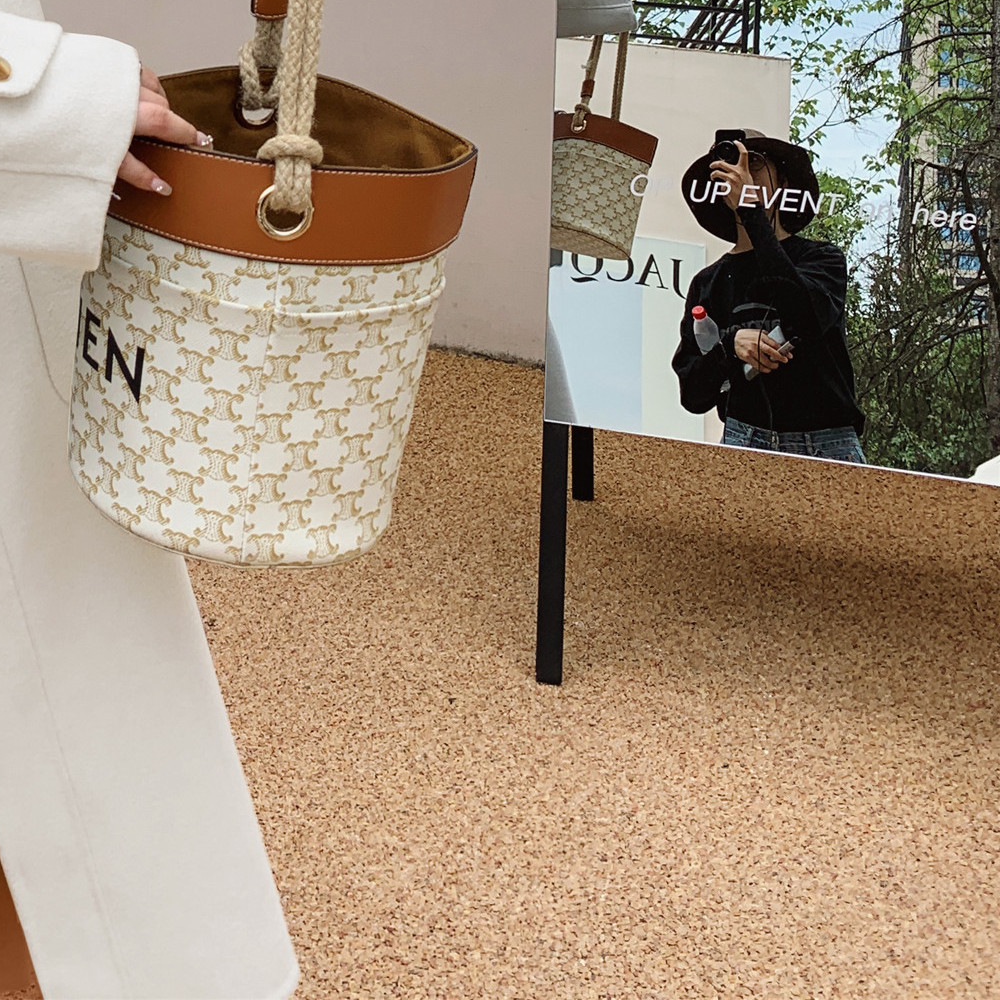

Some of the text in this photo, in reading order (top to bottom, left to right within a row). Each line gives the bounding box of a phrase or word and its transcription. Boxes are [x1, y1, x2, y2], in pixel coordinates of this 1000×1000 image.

[689, 179, 732, 204] UP
[738, 184, 847, 216] EVENT
[911, 201, 977, 231] here
[76, 298, 146, 404] EN
